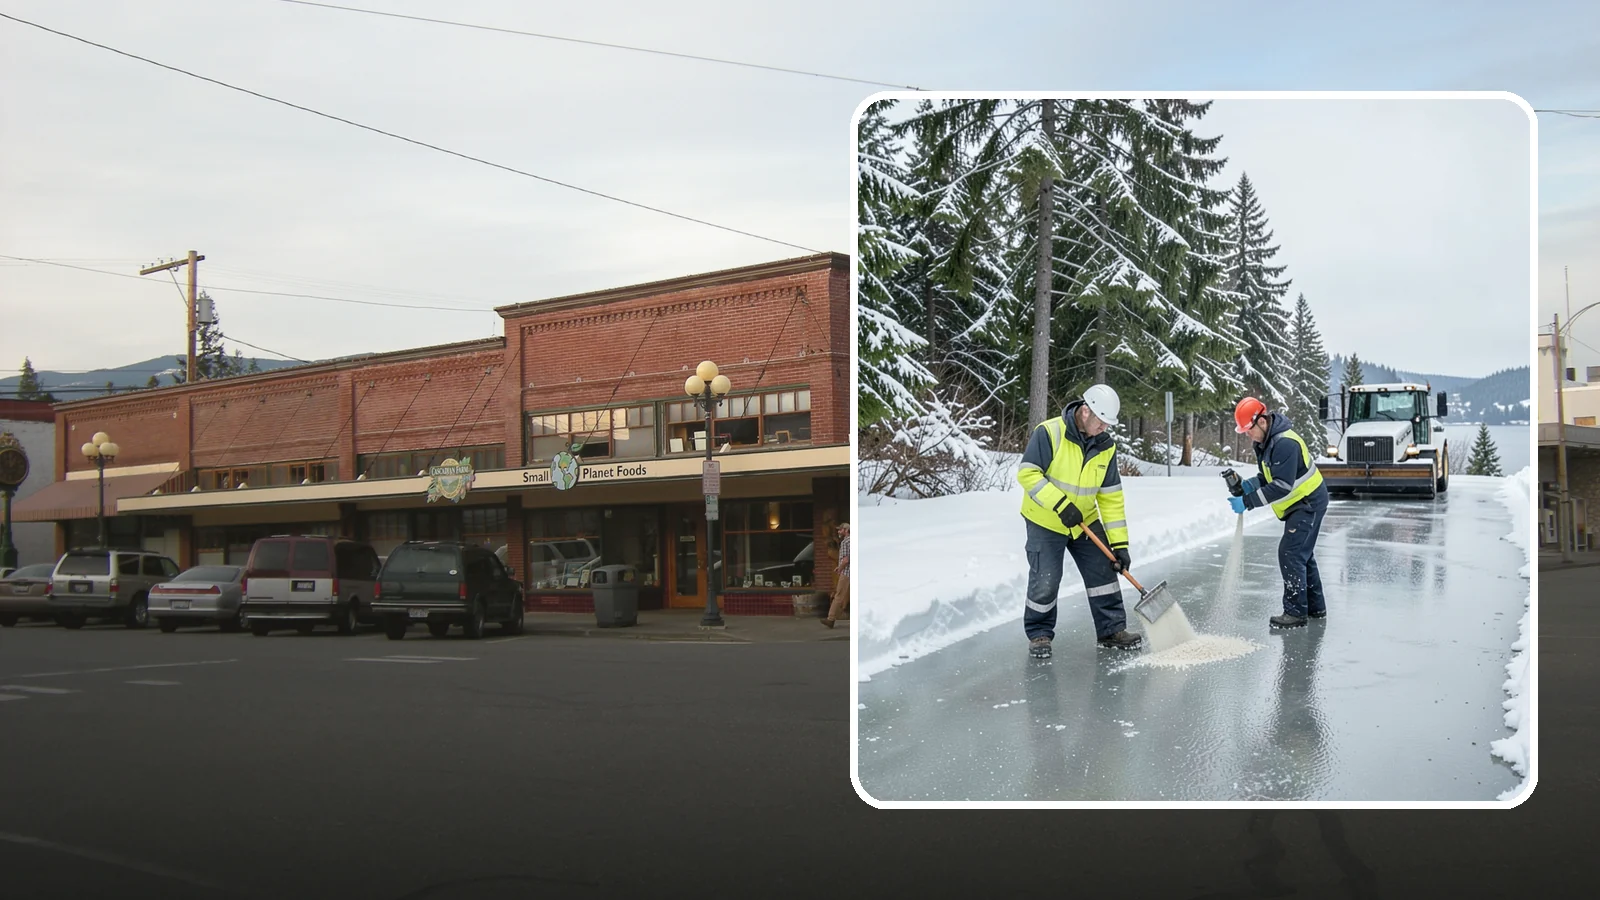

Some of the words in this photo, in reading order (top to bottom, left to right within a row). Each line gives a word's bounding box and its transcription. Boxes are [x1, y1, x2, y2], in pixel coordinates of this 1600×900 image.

[523, 471, 549, 483] Small
[583, 467, 614, 479] Planet
[617, 464, 647, 476] Foods
